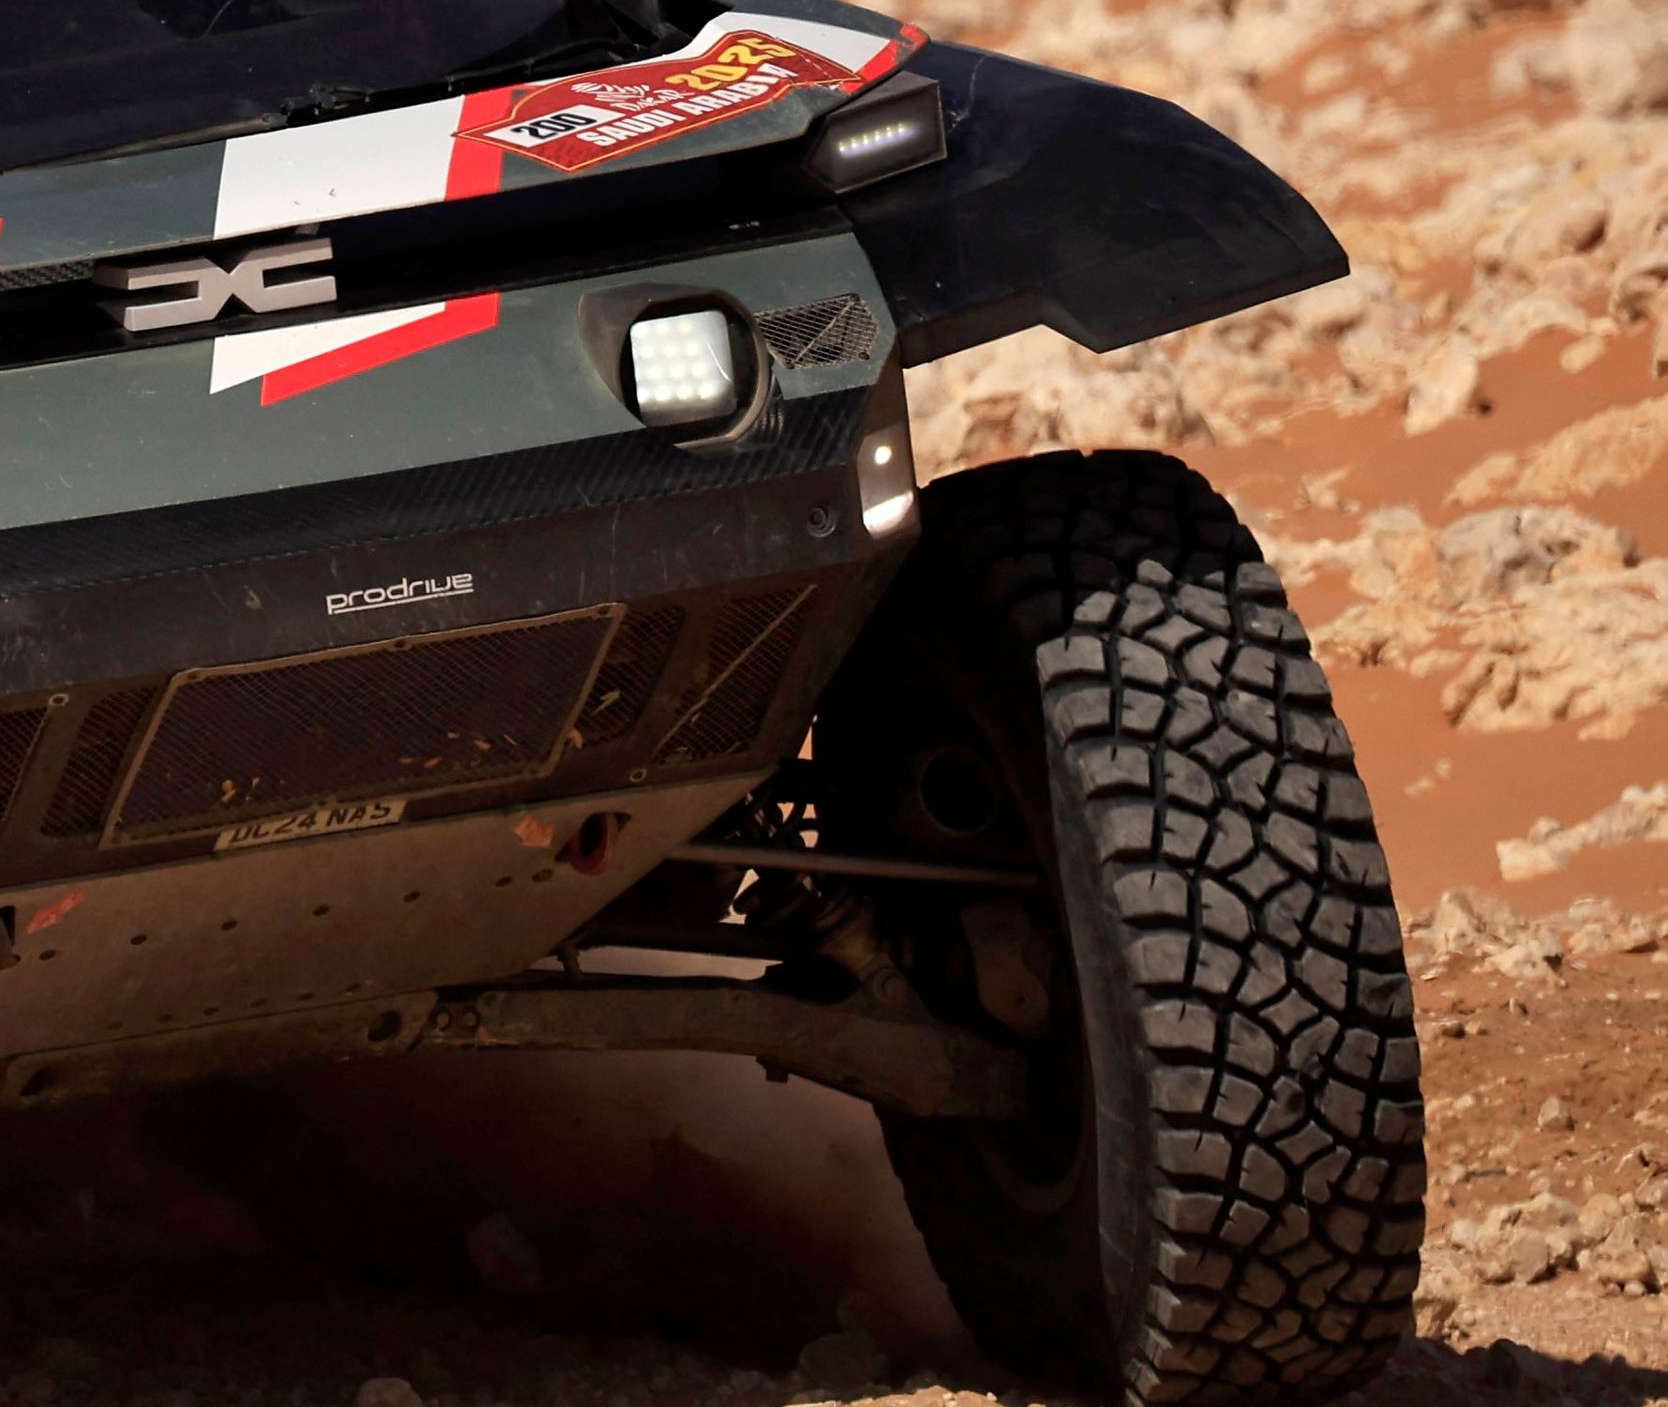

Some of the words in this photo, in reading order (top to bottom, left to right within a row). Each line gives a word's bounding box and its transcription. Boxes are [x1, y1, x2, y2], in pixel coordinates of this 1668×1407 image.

[665, 37, 796, 91] 2025
[511, 111, 598, 140] 200
[576, 108, 687, 146] SAUDI
[671, 63, 798, 115] ARABIA
[326, 571, 474, 615] prodrive
